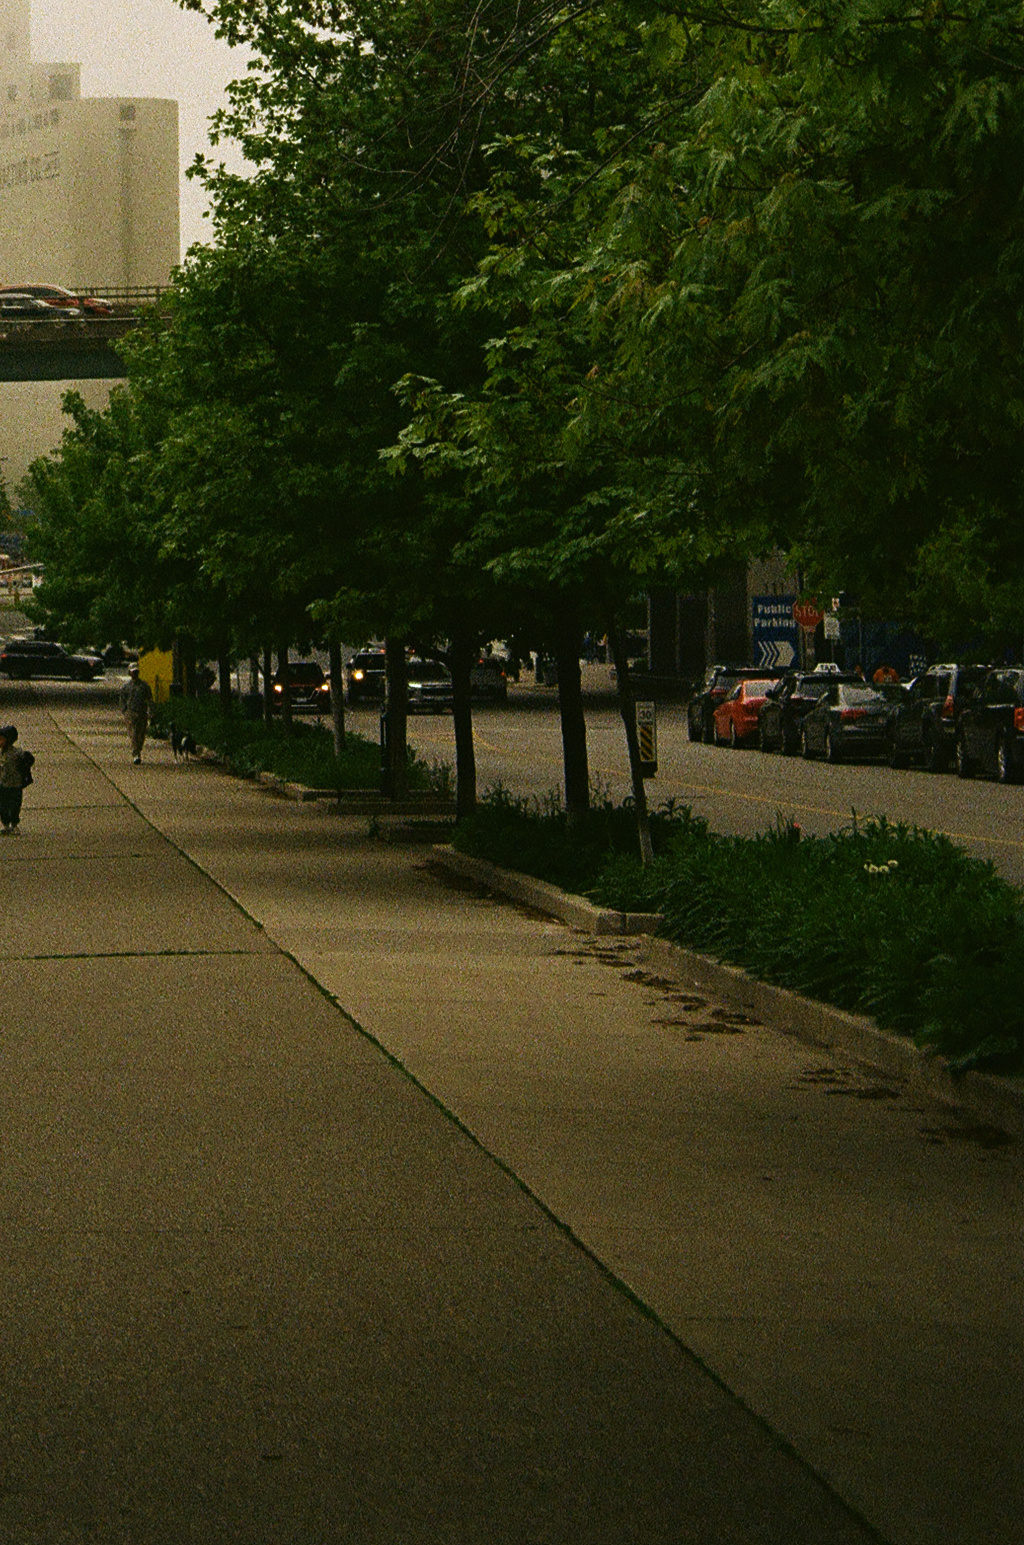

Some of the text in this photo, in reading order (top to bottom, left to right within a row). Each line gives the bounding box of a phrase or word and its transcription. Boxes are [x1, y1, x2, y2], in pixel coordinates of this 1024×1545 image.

[757, 605, 792, 614] Public
[795, 605, 820, 617] STO
[754, 618, 796, 628] Parking
[638, 710, 652, 719] 30
